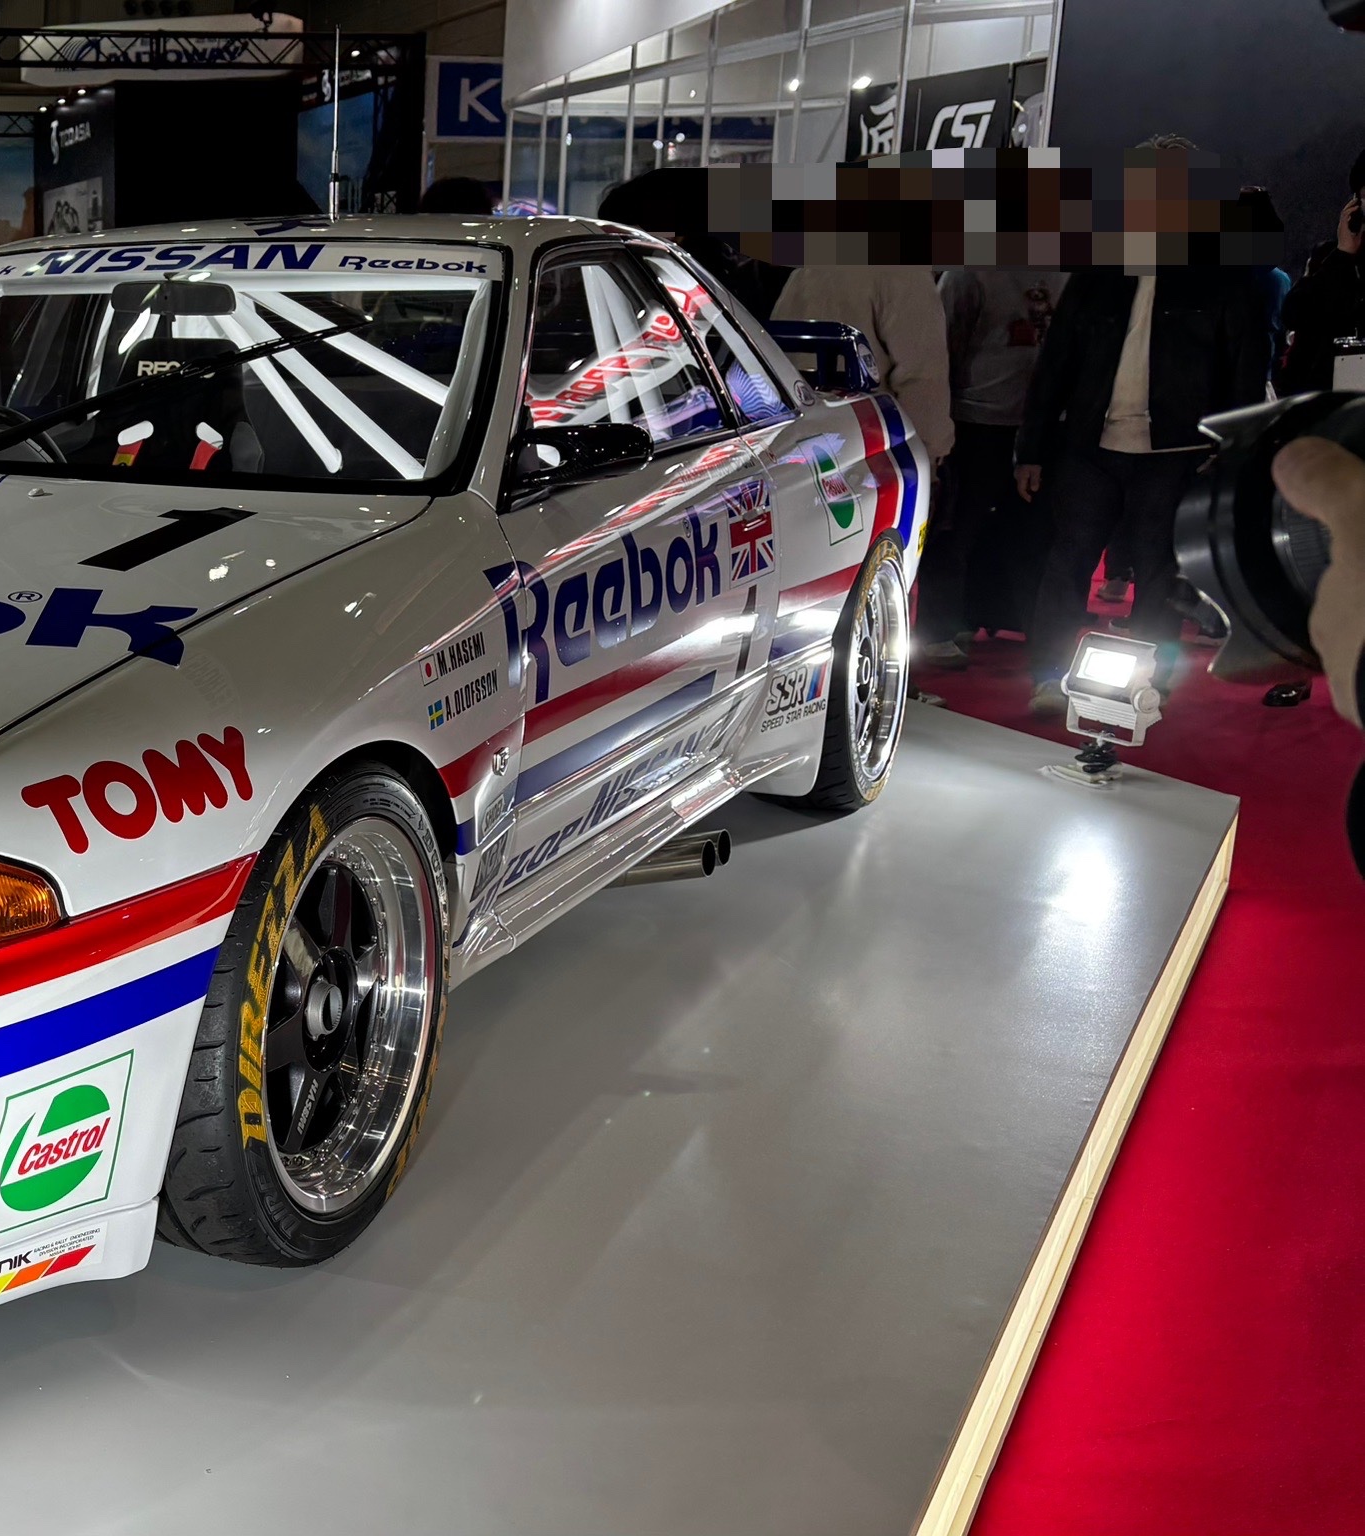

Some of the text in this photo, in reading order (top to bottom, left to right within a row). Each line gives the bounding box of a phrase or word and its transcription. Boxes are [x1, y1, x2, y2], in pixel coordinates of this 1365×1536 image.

[25, 245, 325, 276] NISSAN
[338, 255, 488, 275] Reebok
[77, 506, 259, 572] 1
[483, 504, 722, 705] Reebok
[436, 631, 486, 678] M.HASEMI
[445, 669, 498, 722] A.OLOFSSON
[760, 699, 827, 733] SPEED STAR RACING
[765, 666, 808, 717] SSR
[21, 726, 254, 855] TOMY
[295, 1078, 320, 1135] HASEMI
[17, 1117, 111, 1176] Castrol
